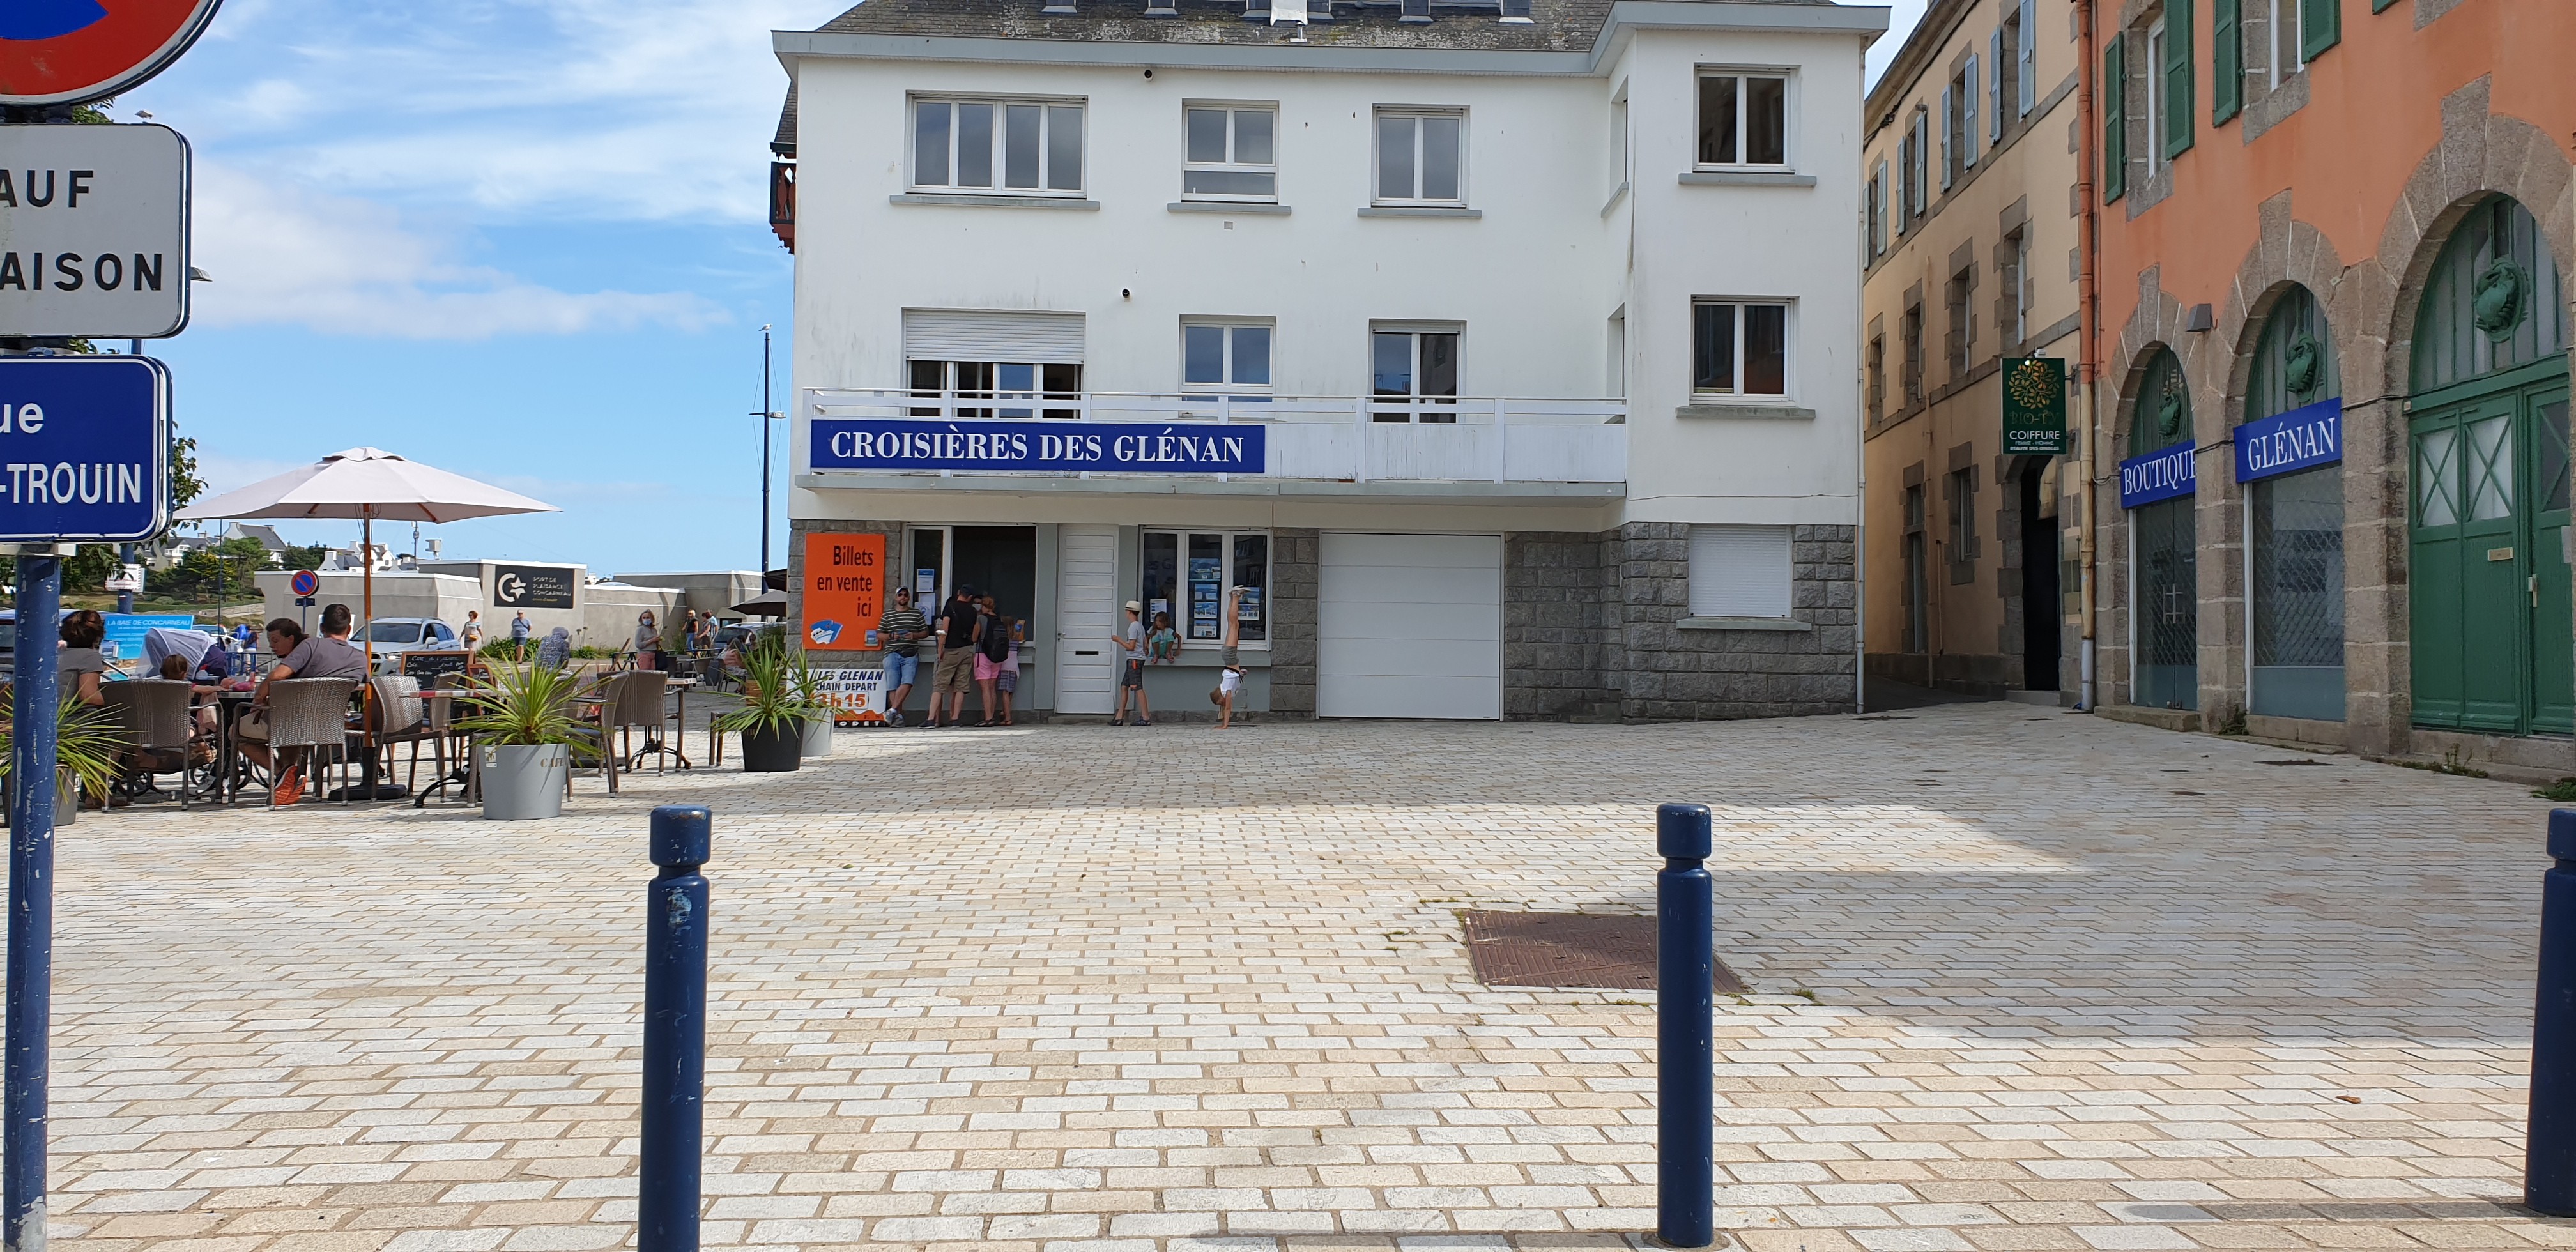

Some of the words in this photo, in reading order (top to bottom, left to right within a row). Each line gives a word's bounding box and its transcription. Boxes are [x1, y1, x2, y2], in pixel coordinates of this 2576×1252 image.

[832, 424, 1027, 459] CROISIÈRES
[1039, 434, 1101, 461] DES
[1114, 427, 1244, 462] GLÉNAN
[2009, 431, 2060, 440] COIFFURE
[2248, 417, 2336, 471] GLÉNAN
[833, 545, 873, 566] Billets
[817, 576, 832, 591] en
[837, 574, 873, 592] vente
[857, 596, 871, 617] ici
[839, 671, 884, 681] GLENAN
[845, 682, 877, 691] DEPART
